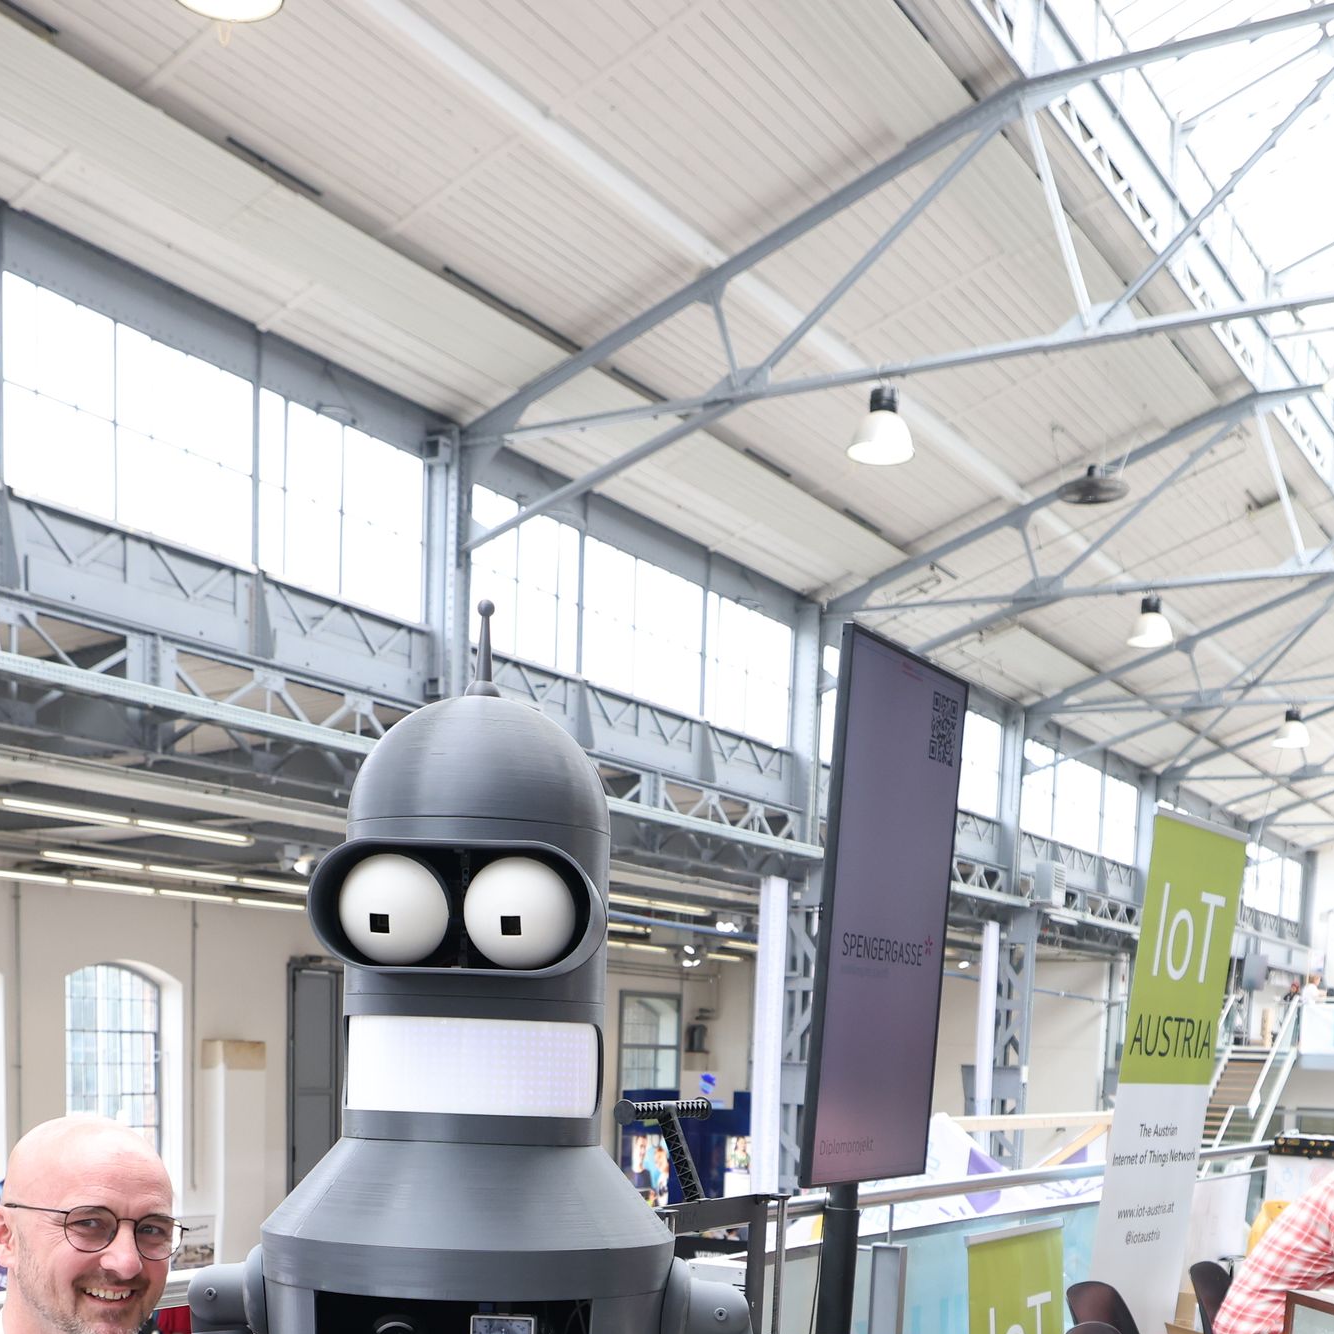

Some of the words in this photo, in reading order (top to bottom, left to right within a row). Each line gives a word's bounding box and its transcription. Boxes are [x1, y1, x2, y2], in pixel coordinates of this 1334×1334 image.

[1151, 881, 1227, 985] IoT
[841, 931, 924, 967] SPENGERGASSE
[1129, 1013, 1212, 1060] AUSTRIA
[1139, 1123, 1152, 1138] The
[1153, 1122, 1178, 1138] Austrian
[819, 1138, 875, 1156] Diplomprojekt
[1112, 1151, 1139, 1167] Internet
[1139, 1149, 1149, 1165] of
[1149, 1149, 1169, 1167] Things
[1117, 1201, 1175, 1220] www.iot-austria.at
